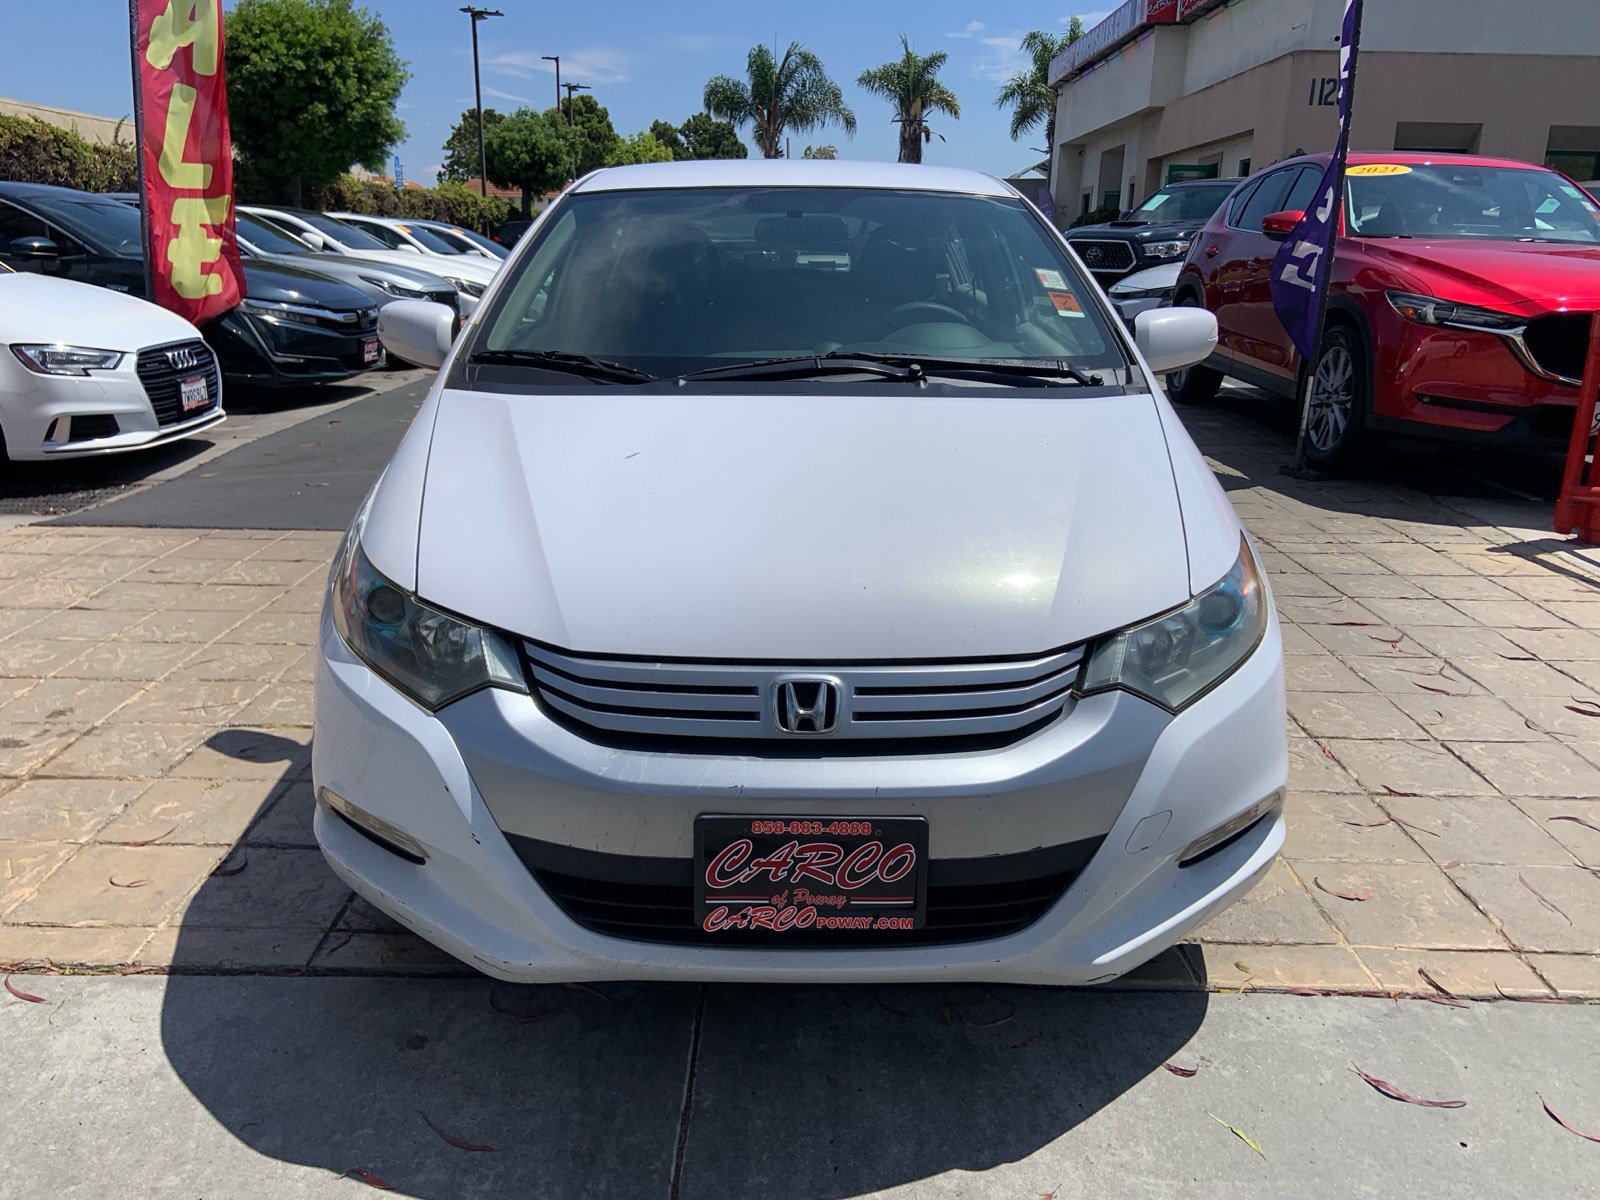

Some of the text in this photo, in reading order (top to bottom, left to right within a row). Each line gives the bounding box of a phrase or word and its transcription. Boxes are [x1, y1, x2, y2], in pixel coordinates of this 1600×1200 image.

[1309, 77, 1341, 106] 112
[1355, 166, 1398, 175] 2021
[751, 821, 872, 835] 858-883-4888
[705, 838, 916, 889] CARCO
[771, 887, 847, 908] of Poway
